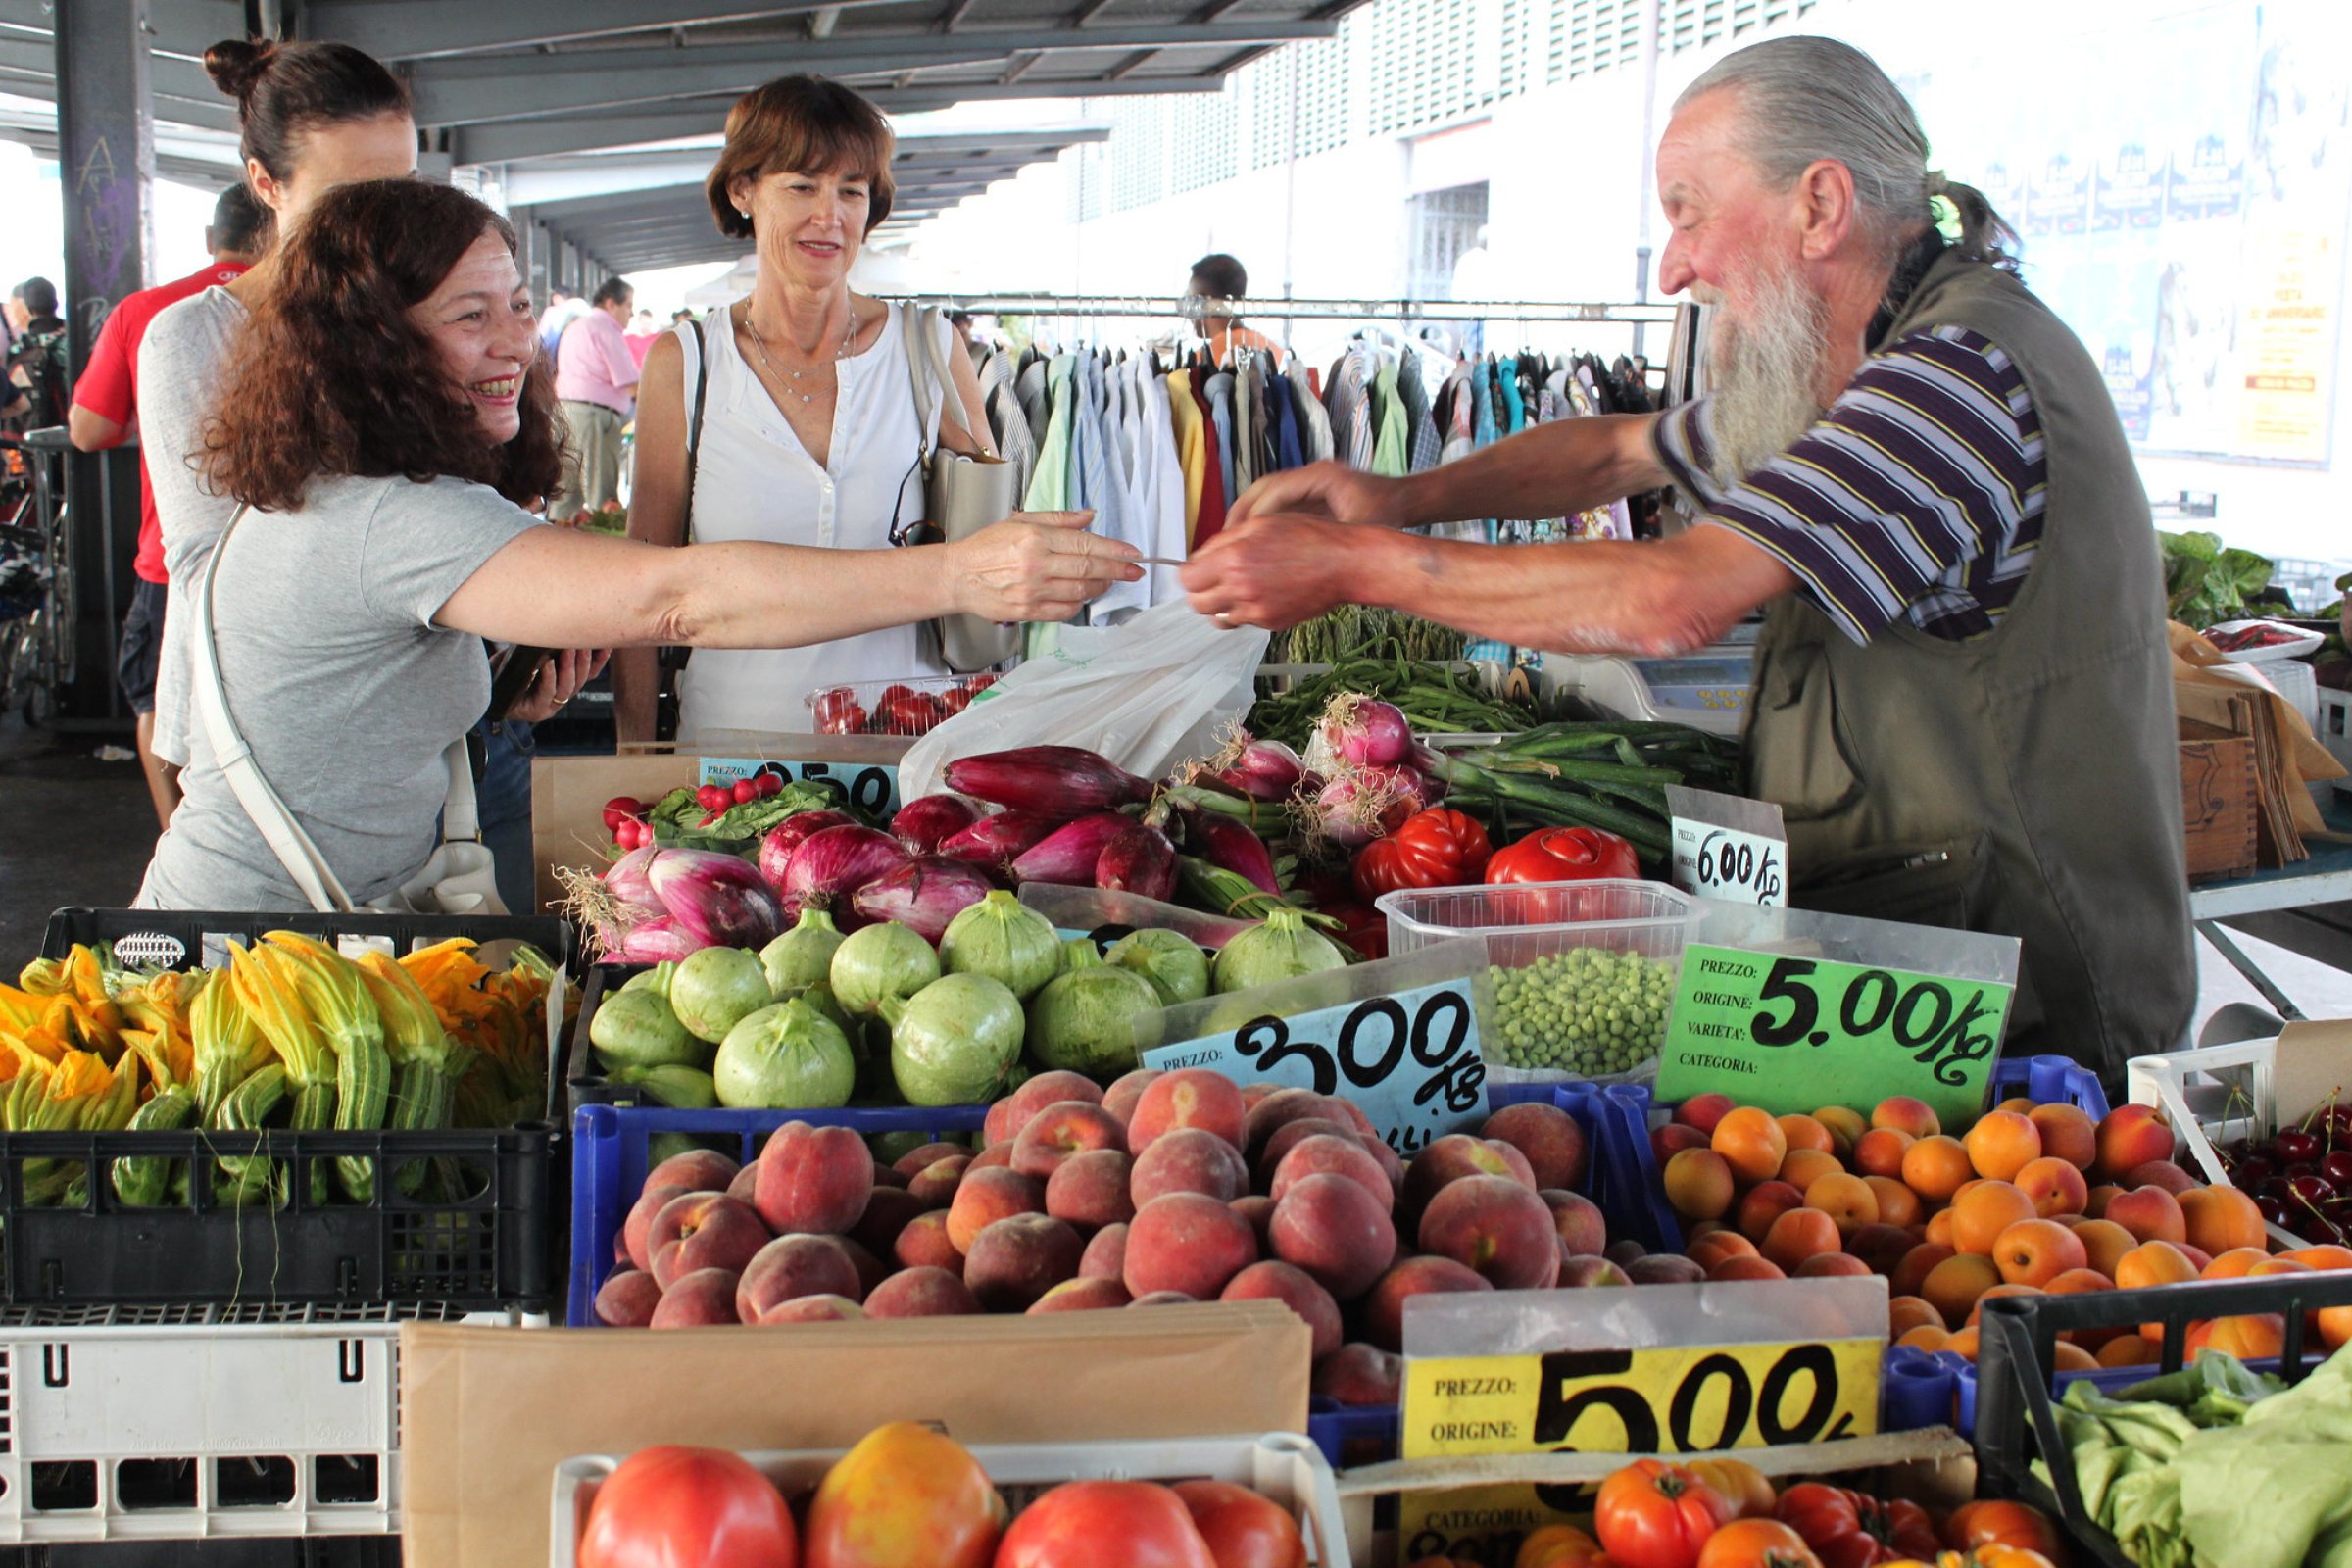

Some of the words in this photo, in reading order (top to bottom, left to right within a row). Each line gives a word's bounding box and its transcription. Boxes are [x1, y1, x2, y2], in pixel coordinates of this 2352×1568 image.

[1700, 959, 1757, 979] PREZZO:
[1693, 991, 1752, 1010] ORIGINE:
[1751, 958, 1952, 1048] 5.00
[1687, 1021, 1745, 1042] VARIETA':
[1163, 1049, 1224, 1072] PREZZO:
[1679, 1053, 1758, 1075] CATEGORIA:
[1434, 1378, 1517, 1396] PREZZO:
[1431, 1422, 1517, 1441] ORIGINE:
[1425, 1507, 1542, 1531] CATEGORIA:
